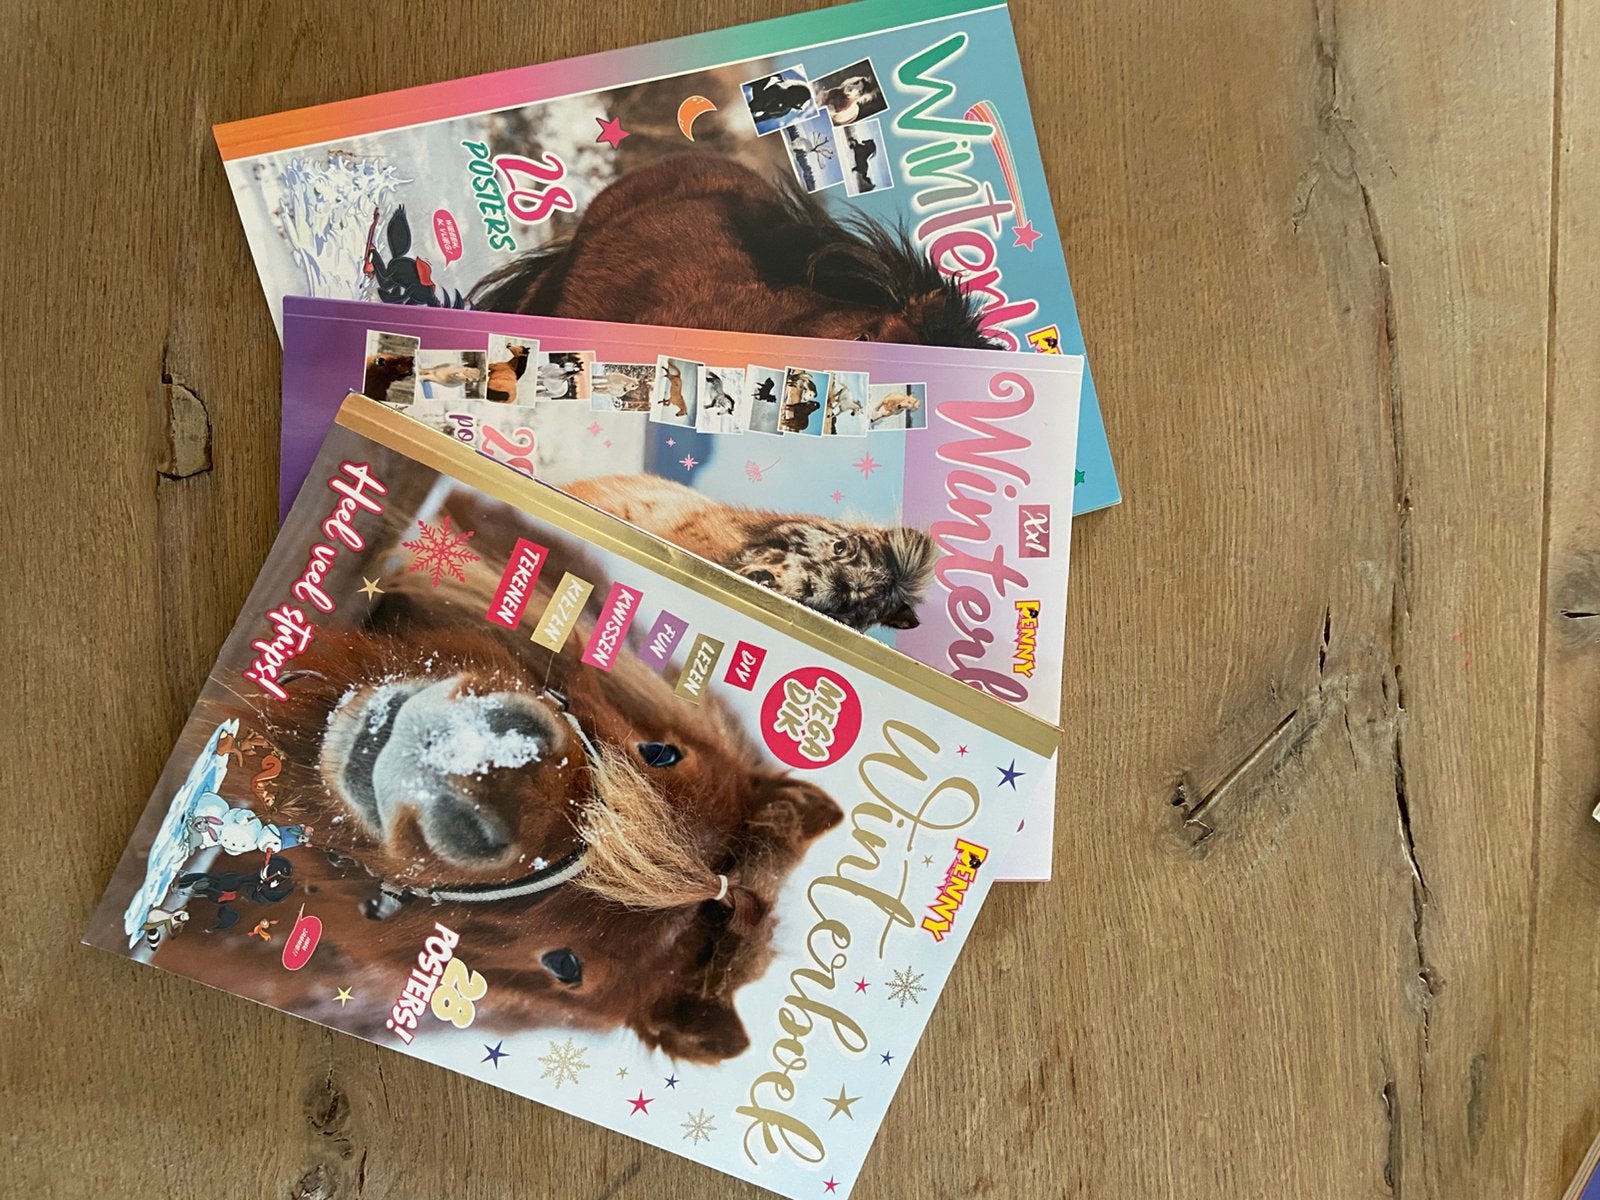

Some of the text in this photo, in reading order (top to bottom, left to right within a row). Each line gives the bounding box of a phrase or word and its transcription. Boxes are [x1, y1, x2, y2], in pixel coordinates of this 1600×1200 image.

[460, 140, 516, 251] POSTERS
[493, 152, 576, 224] 28
[895, 32, 1038, 351] Winterb
[448, 414, 474, 442] po
[482, 424, 535, 475] 2
[930, 371, 1035, 702] Winterb
[244, 460, 388, 702] Heel veel strips!
[496, 547, 541, 626] TEKENEN
[544, 579, 585, 643] KIEZEN
[592, 588, 636, 668] KWISSEN
[649, 618, 677, 660] FUN
[683, 639, 716, 696] LEZEN
[739, 648, 757, 683] DIY
[1013, 600, 1041, 679] PENNY
[773, 678, 814, 742] DIK
[797, 676, 847, 762] MEGA
[921, 837, 989, 942] PENNY
[735, 719, 980, 1166] Winterboek
[386, 921, 460, 1045] POSTERS!
[431, 957, 488, 1029] 28
